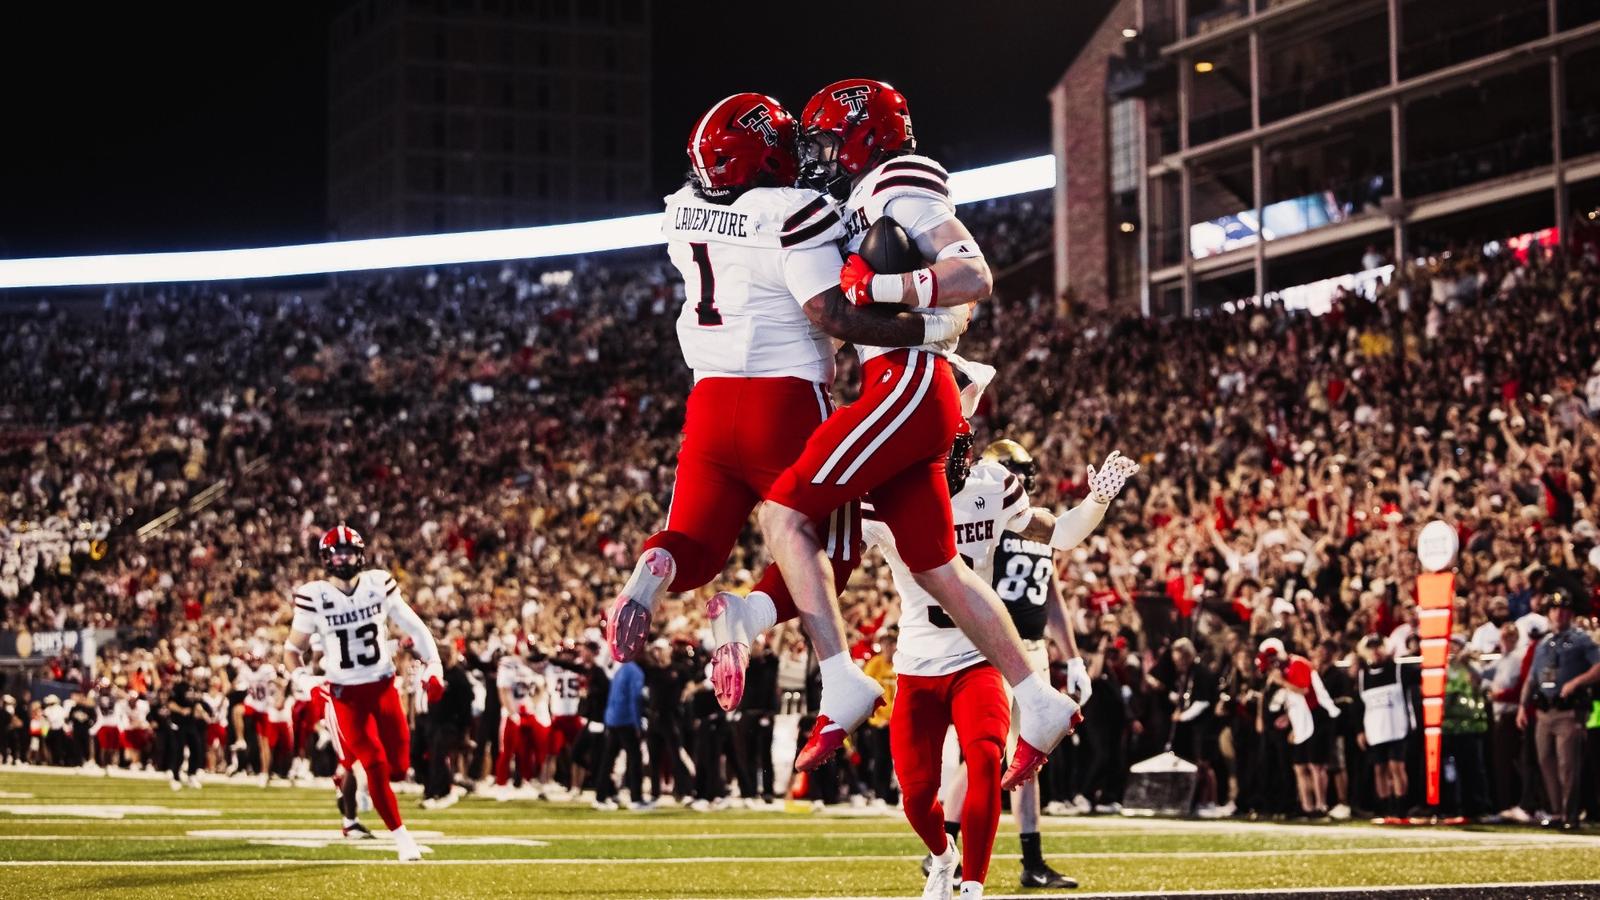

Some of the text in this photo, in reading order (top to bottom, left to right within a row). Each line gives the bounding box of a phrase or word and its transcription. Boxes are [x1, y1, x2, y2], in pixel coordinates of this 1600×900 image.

[675, 206, 748, 238] LAVENTURE
[688, 242, 723, 326] 1
[954, 519, 995, 545] TECH
[325, 602, 382, 627] TEXAS TECH
[335, 622, 381, 670] 13
